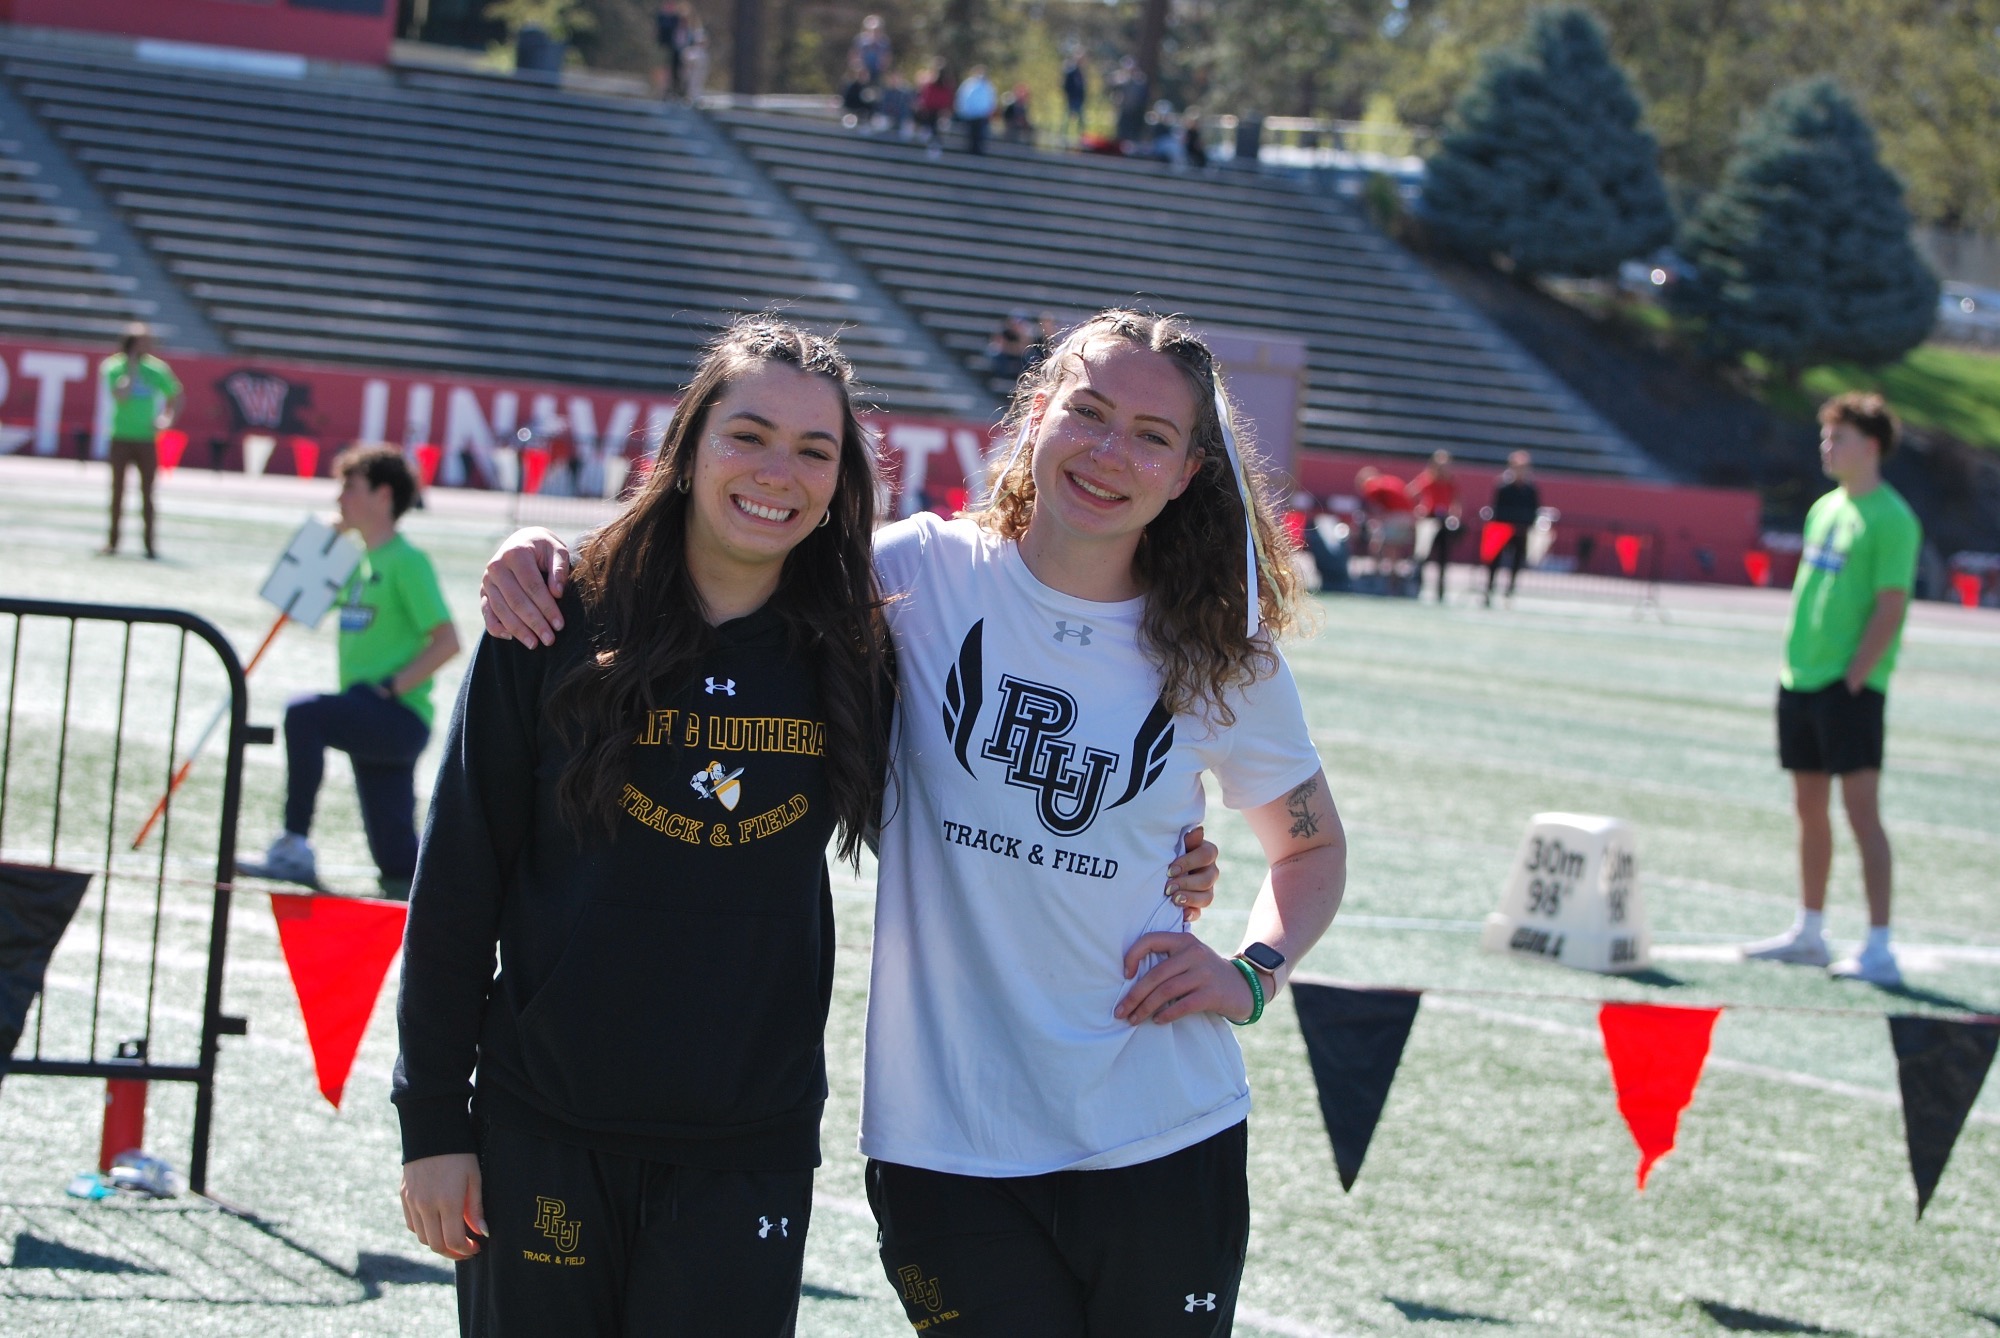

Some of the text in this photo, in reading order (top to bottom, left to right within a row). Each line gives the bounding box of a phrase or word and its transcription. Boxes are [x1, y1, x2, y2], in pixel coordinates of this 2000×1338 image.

[708, 716, 827, 757] LUTHERA
[981, 673, 1120, 838] PLU
[618, 783, 809, 847] TRACK & FIELD
[943, 820, 1119, 880] TRACK & FIELD
[534, 1195, 582, 1253] PLU
[523, 1250, 585, 1265] TRACK & FIELD
[939, 1310, 960, 1321] FIELD
